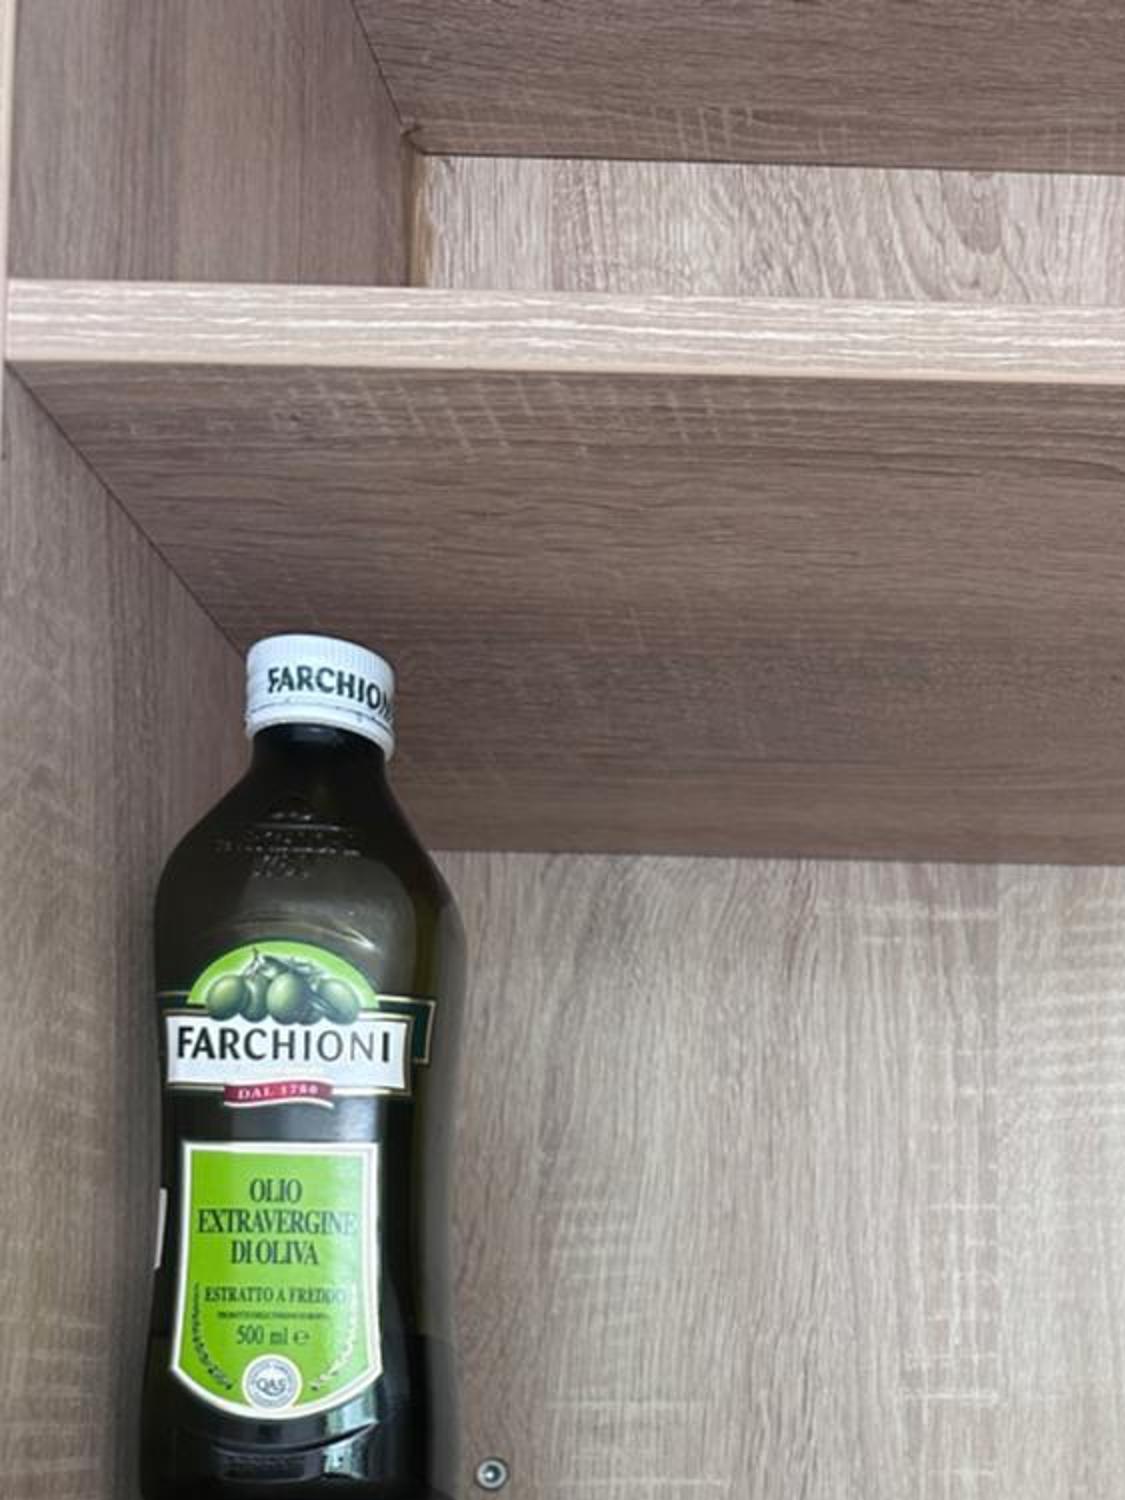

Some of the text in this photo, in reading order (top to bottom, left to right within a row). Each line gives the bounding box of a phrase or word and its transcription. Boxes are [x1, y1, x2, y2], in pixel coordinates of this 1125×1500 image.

[177, 1025, 391, 1063] FARCHIONI
[249, 1178, 303, 1203] OLIO
[198, 1208, 355, 1235] EXTRAVERGINE
[231, 1239, 319, 1266] DI OLIVA
[204, 1286, 274, 1303] ESTRATTO
[236, 1324, 265, 1345] 500
[269, 1327, 289, 1346] ml
